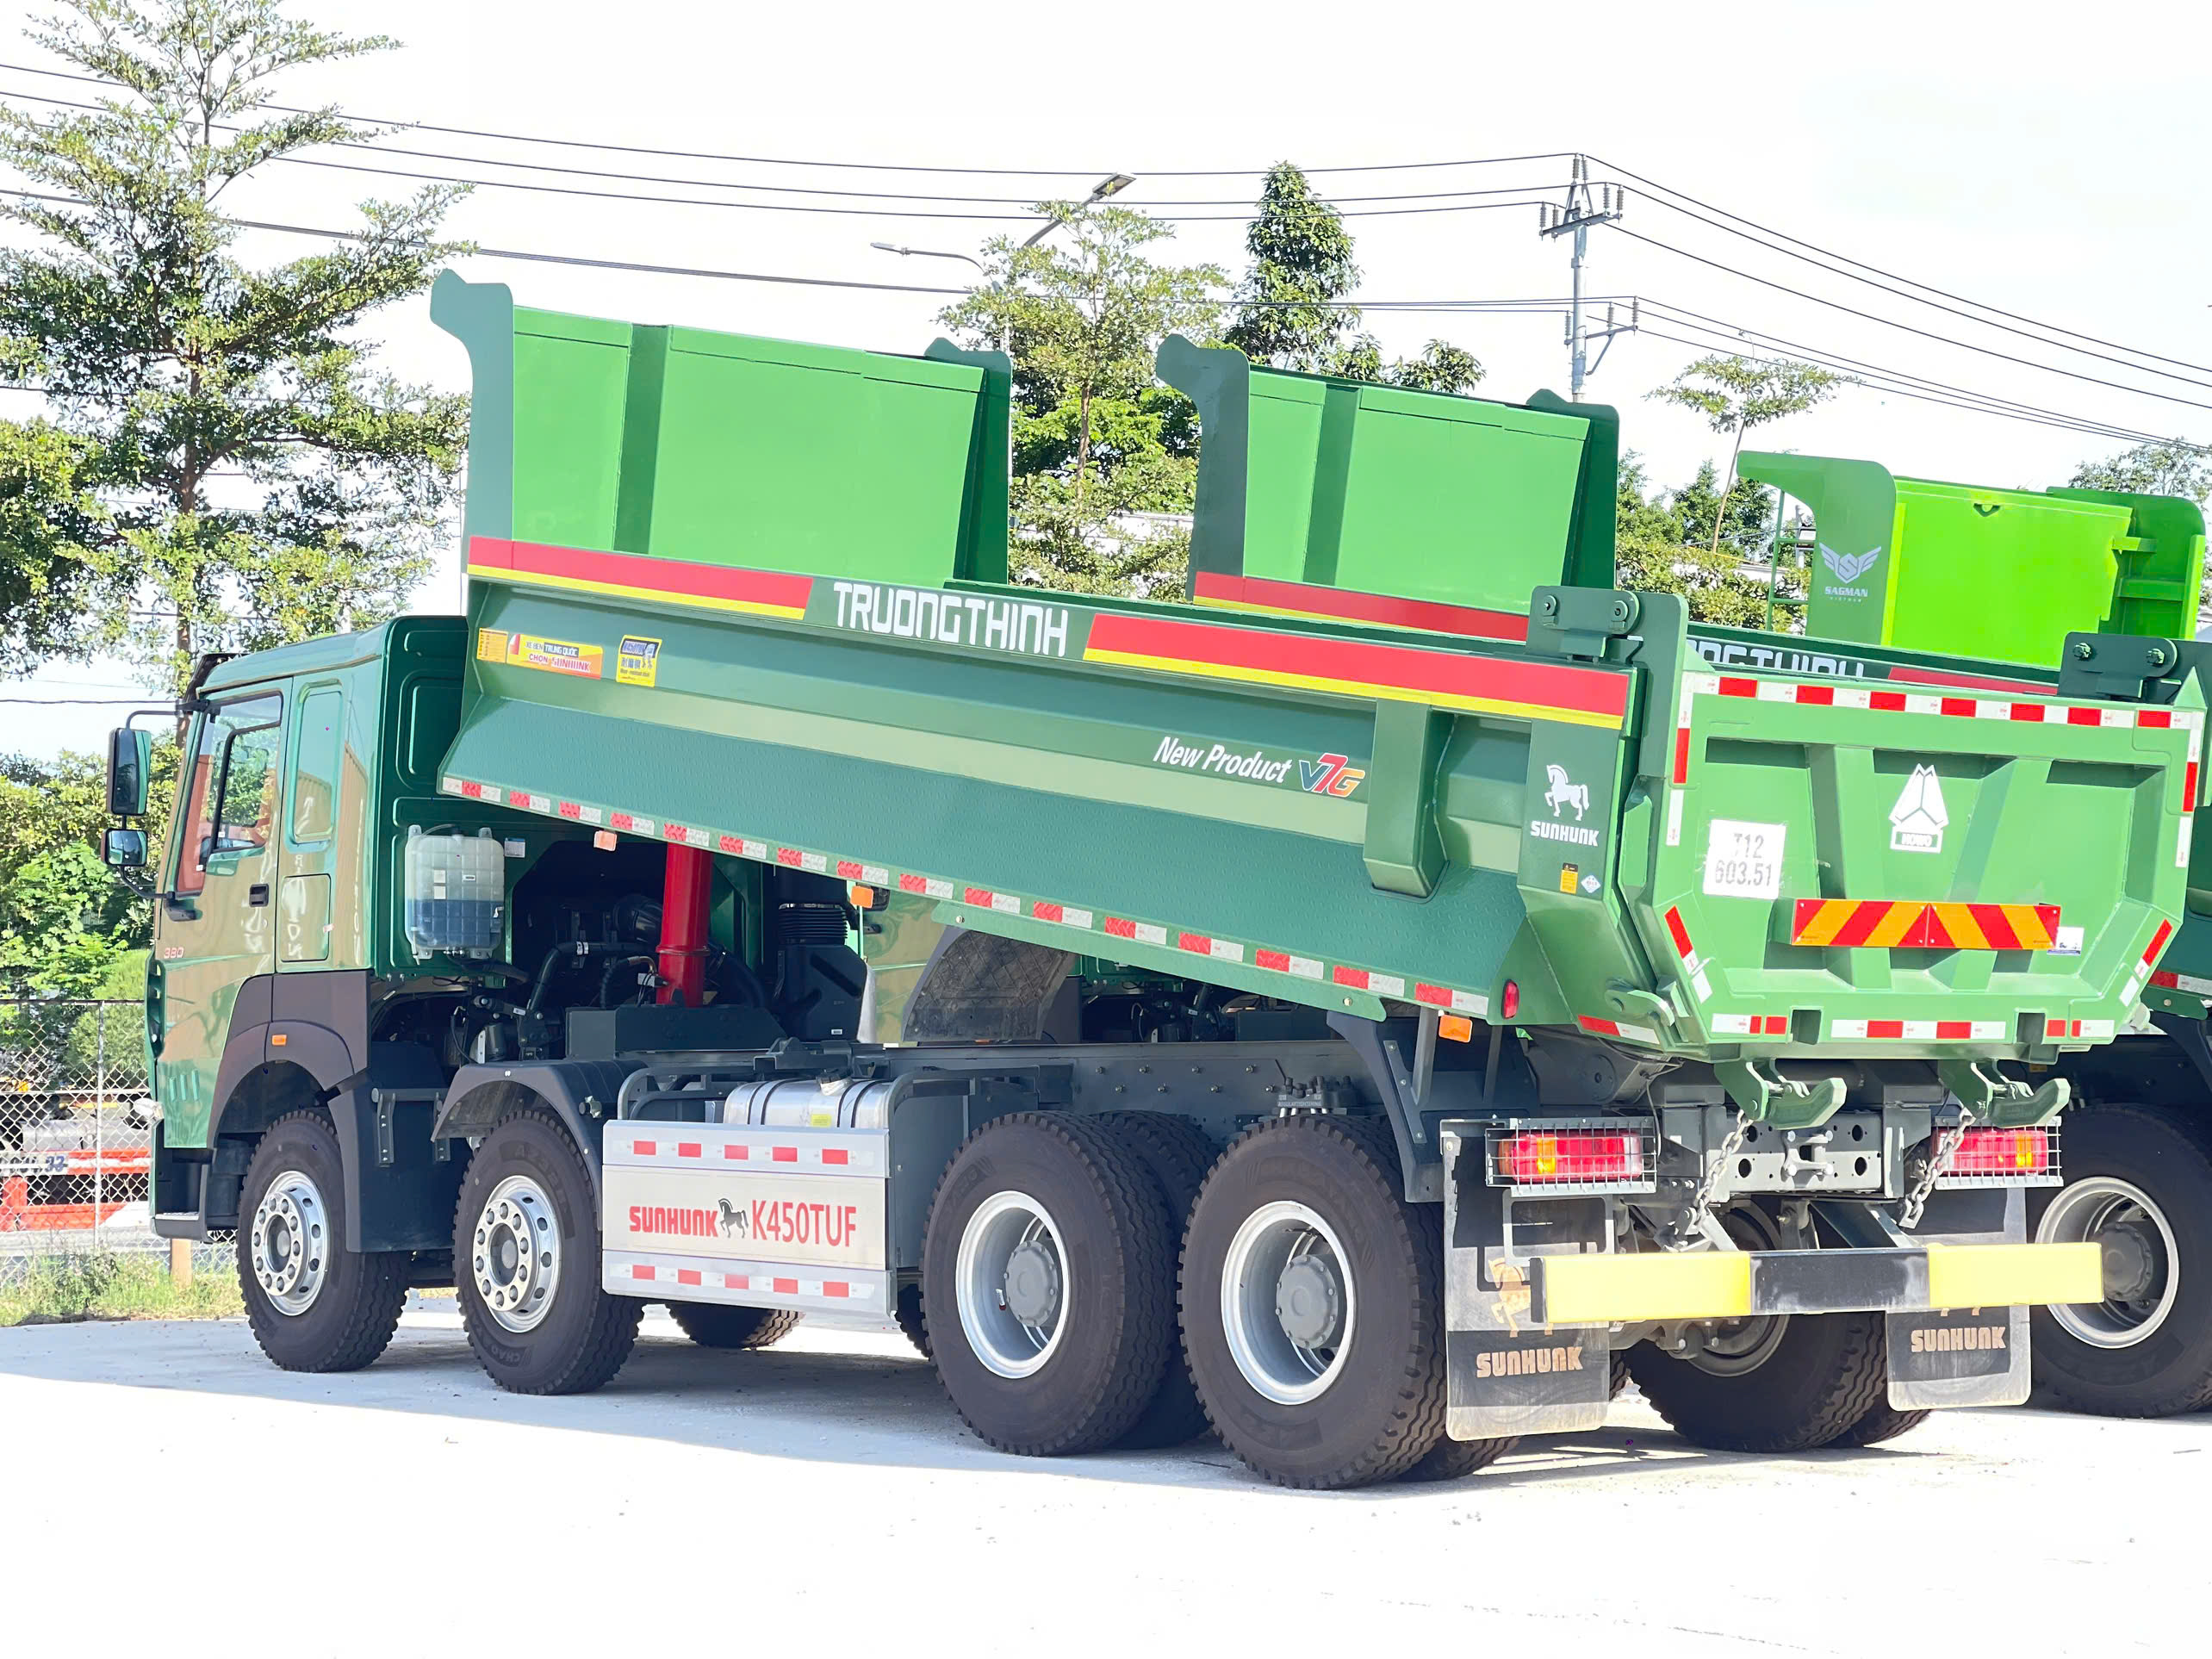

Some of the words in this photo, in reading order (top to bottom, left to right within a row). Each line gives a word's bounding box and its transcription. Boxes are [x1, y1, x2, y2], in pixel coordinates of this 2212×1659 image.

[1824, 586, 1868, 597] SAGMAN
[833, 581, 1069, 657] TRUONGTHINH
[1153, 736, 1205, 767] New
[1201, 744, 1293, 783] Product
[1530, 820, 1600, 847] SUNHUNK
[1715, 860, 1772, 886] 603.51
[629, 1205, 718, 1238] SUNHUNK
[751, 1199, 857, 1248] K450TUF
[1911, 1327, 2007, 1353] SUNHUNK
[1476, 1346, 1583, 1378] SUNHUNK
